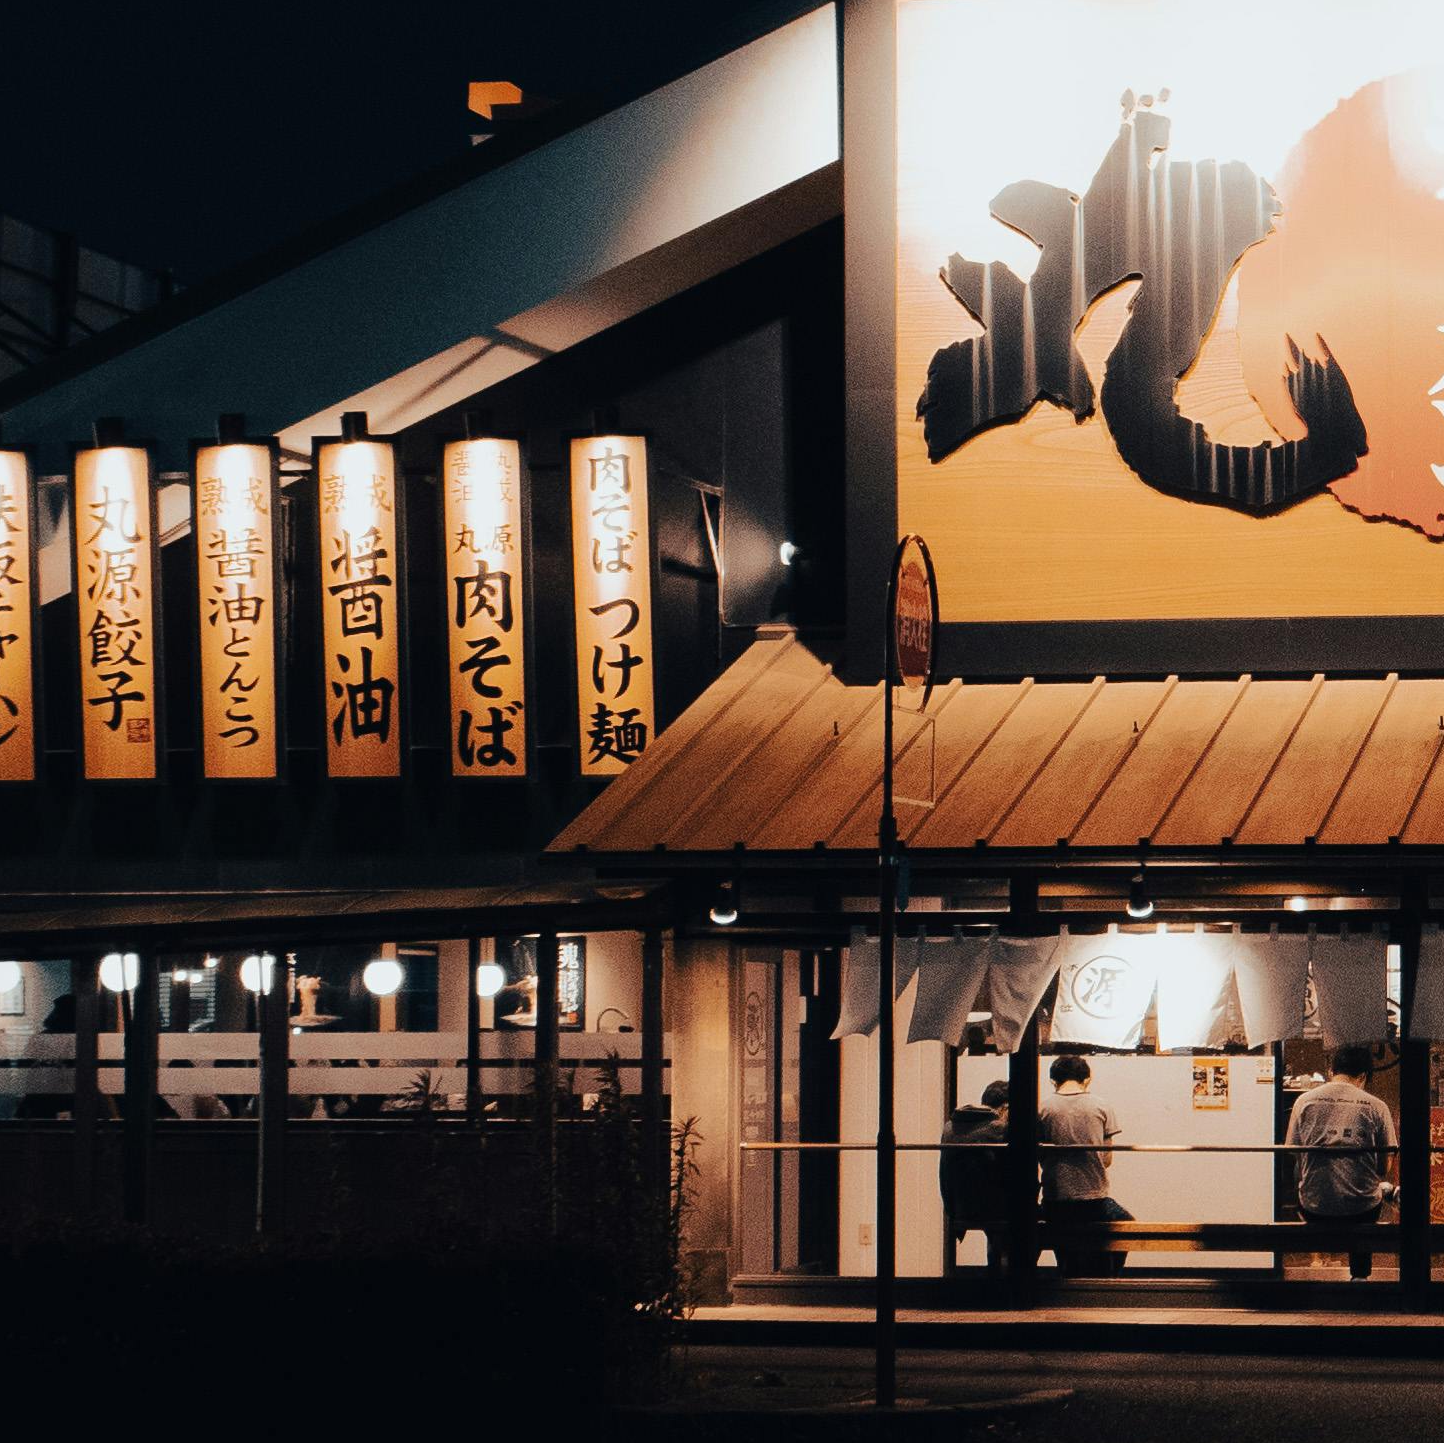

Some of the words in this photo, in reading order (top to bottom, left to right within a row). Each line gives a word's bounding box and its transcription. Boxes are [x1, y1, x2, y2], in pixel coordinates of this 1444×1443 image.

[85, 485, 146, 732] 丸源餃子
[206, 529, 266, 749] 醤油とんこつ
[327, 525, 396, 746] 醤油
[453, 557, 524, 769] 肉そば
